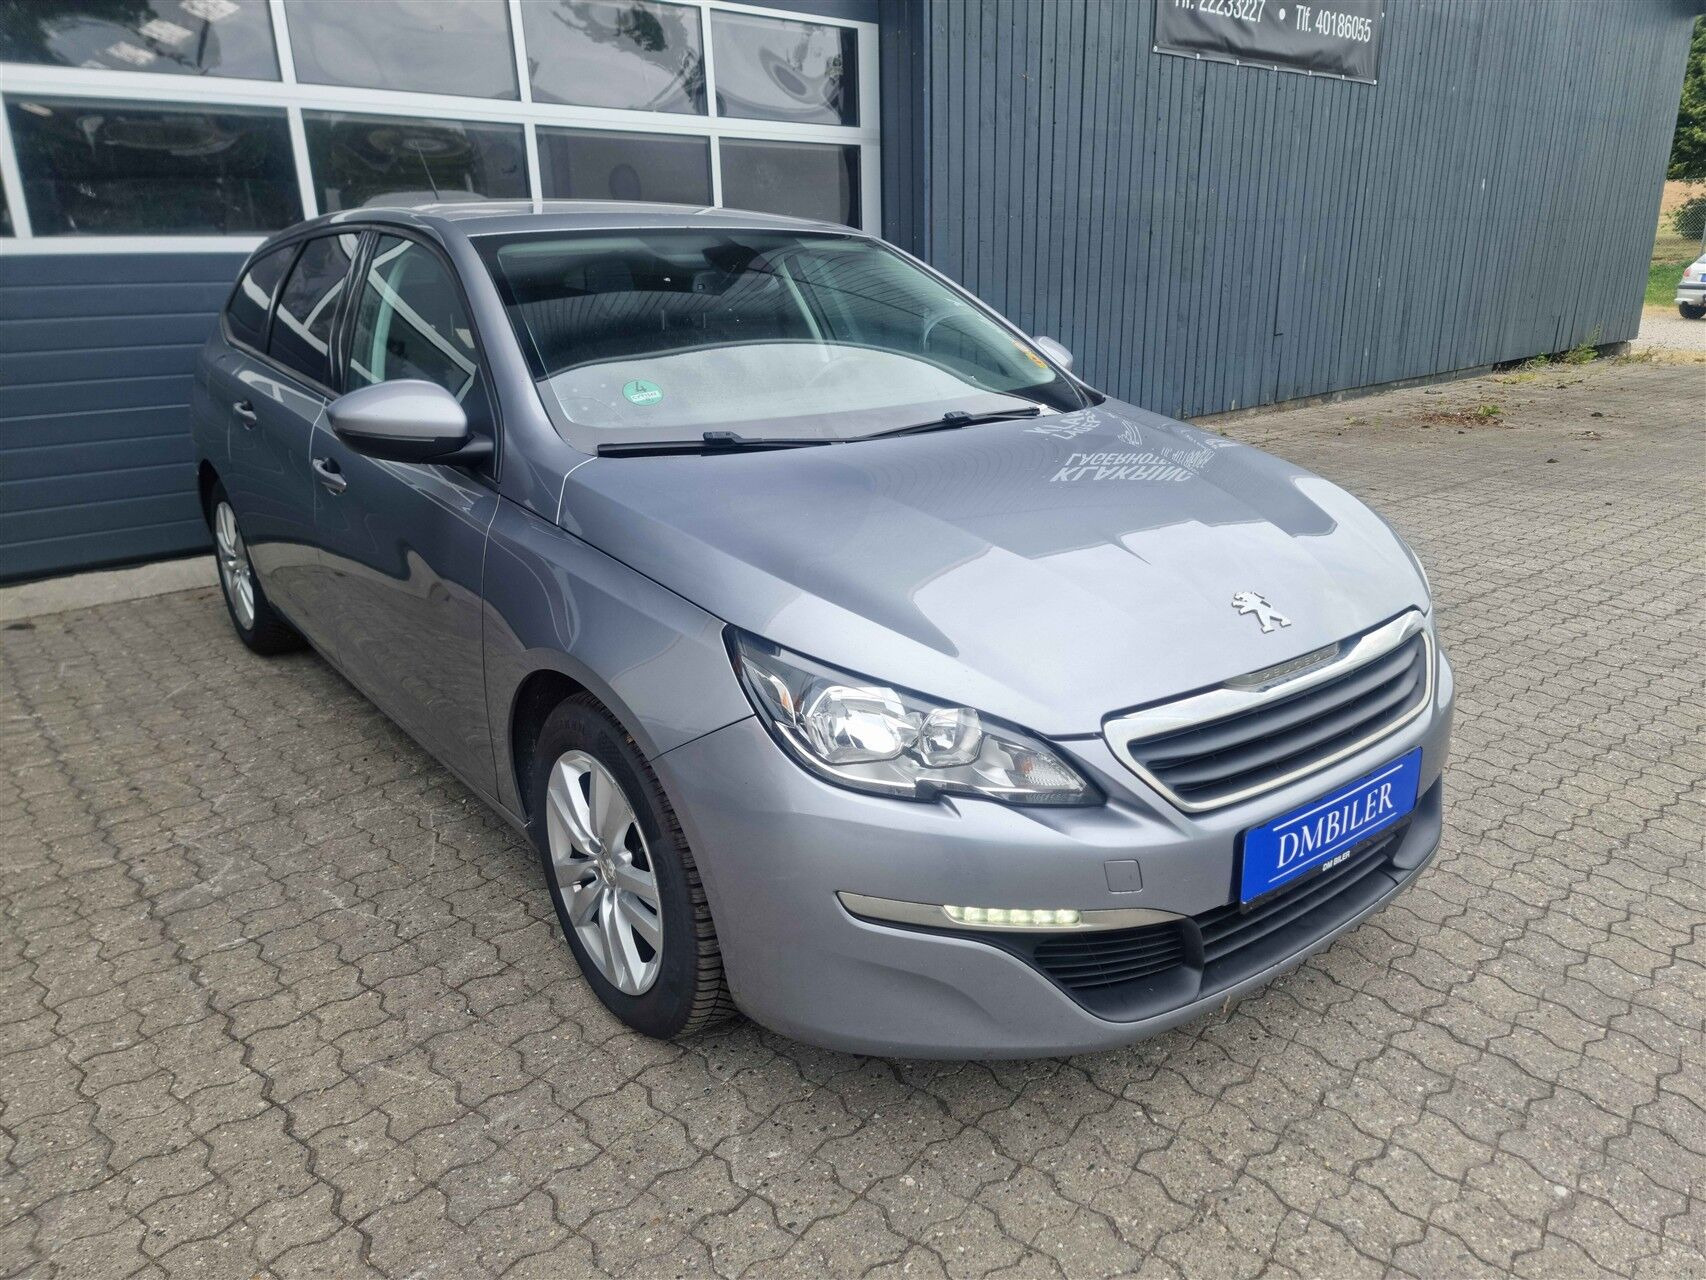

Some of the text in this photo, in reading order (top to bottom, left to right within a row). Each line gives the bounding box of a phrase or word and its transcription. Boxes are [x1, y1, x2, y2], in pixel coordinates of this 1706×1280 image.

[1296, 4, 1311, 32] Tlf.
[1315, 9, 1372, 43] 40186055
[1277, 782, 1393, 869] DMBILER
[1322, 850, 1350, 871] DM BILER
